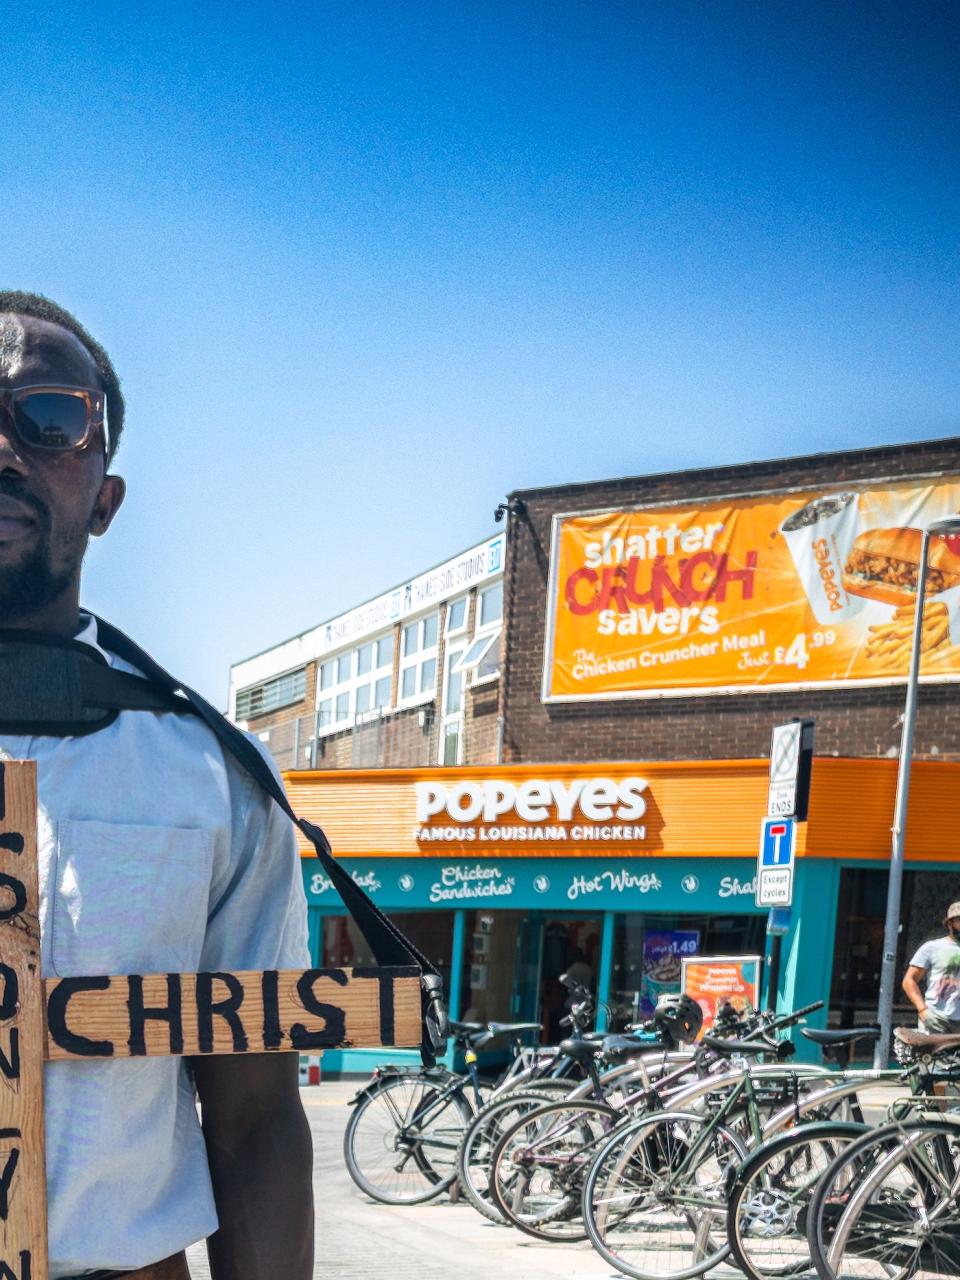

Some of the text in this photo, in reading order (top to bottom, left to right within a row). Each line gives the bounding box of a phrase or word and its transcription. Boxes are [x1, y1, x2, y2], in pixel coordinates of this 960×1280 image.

[584, 520, 724, 568] shatter
[565, 551, 757, 616] CRUNCH
[597, 605, 721, 636] savers
[571, 629, 766, 680] Chicken Cruncher Meal
[771, 800, 793, 815] ENDS
[413, 825, 646, 842] FAMOUS LOUISIANA CHICKEN
[441, 864, 502, 886] Chicken
[567, 868, 658, 900] Hot Wings
[763, 873, 788, 886] Except
[429, 879, 513, 903] Sandwiches
[763, 886, 786, 899] cycles
[47, 965, 421, 1057] CHRIST
